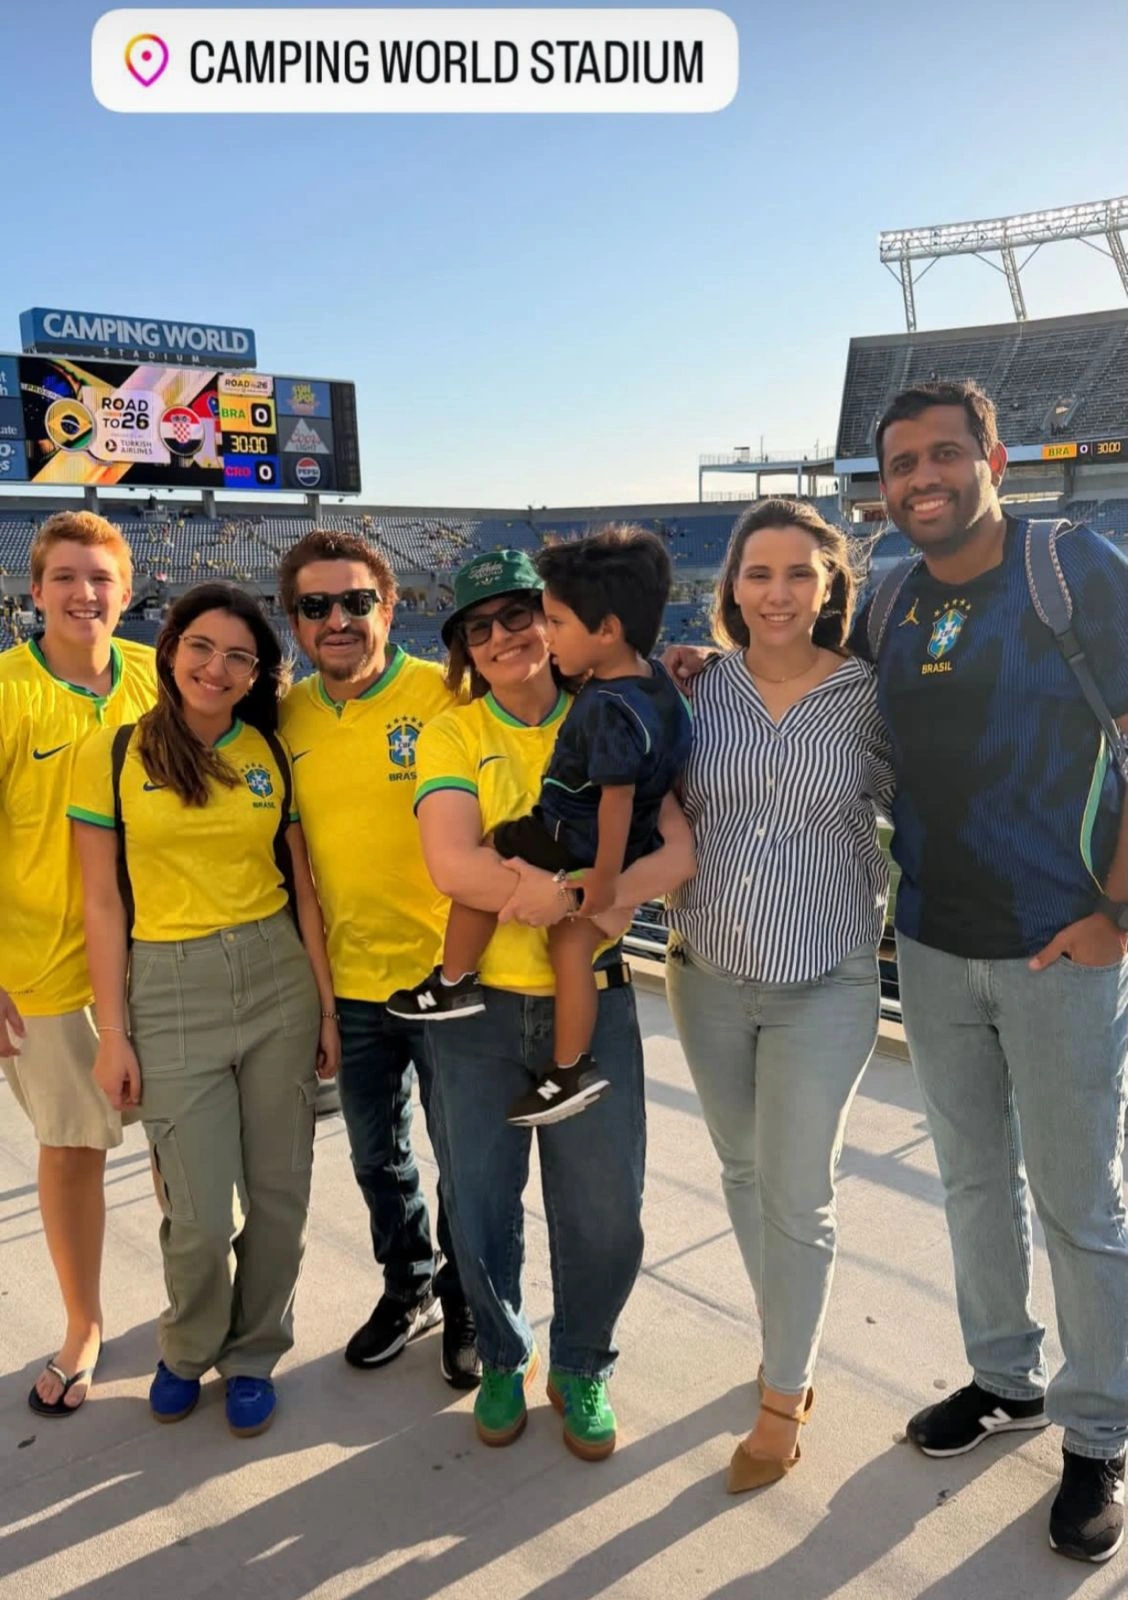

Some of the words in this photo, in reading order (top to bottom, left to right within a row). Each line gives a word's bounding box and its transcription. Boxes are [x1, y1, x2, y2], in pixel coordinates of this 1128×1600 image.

[43, 313, 160, 347] CAMPING
[163, 327, 249, 354] WORLD
[103, 347, 200, 363] STADIUM
[225, 378, 250, 389] ROAD
[101, 397, 149, 412] ROAD
[103, 418, 120, 429] TO
[121, 412, 150, 430] 26
[221, 407, 246, 419] BRA
[254, 407, 268, 424] 0
[120, 440, 152, 448] TURKISH
[120, 447, 153, 455] AIRLINES
[230, 435, 268, 454] 30:00
[1048, 447, 1070, 457] BRA
[258, 464, 273, 481] 0
[921, 661, 952, 675] BRASIL
[388, 771, 417, 782] BRAS
[417, 990, 438, 1010] N
[537, 1080, 562, 1101] N
[978, 1407, 1013, 1432] N
